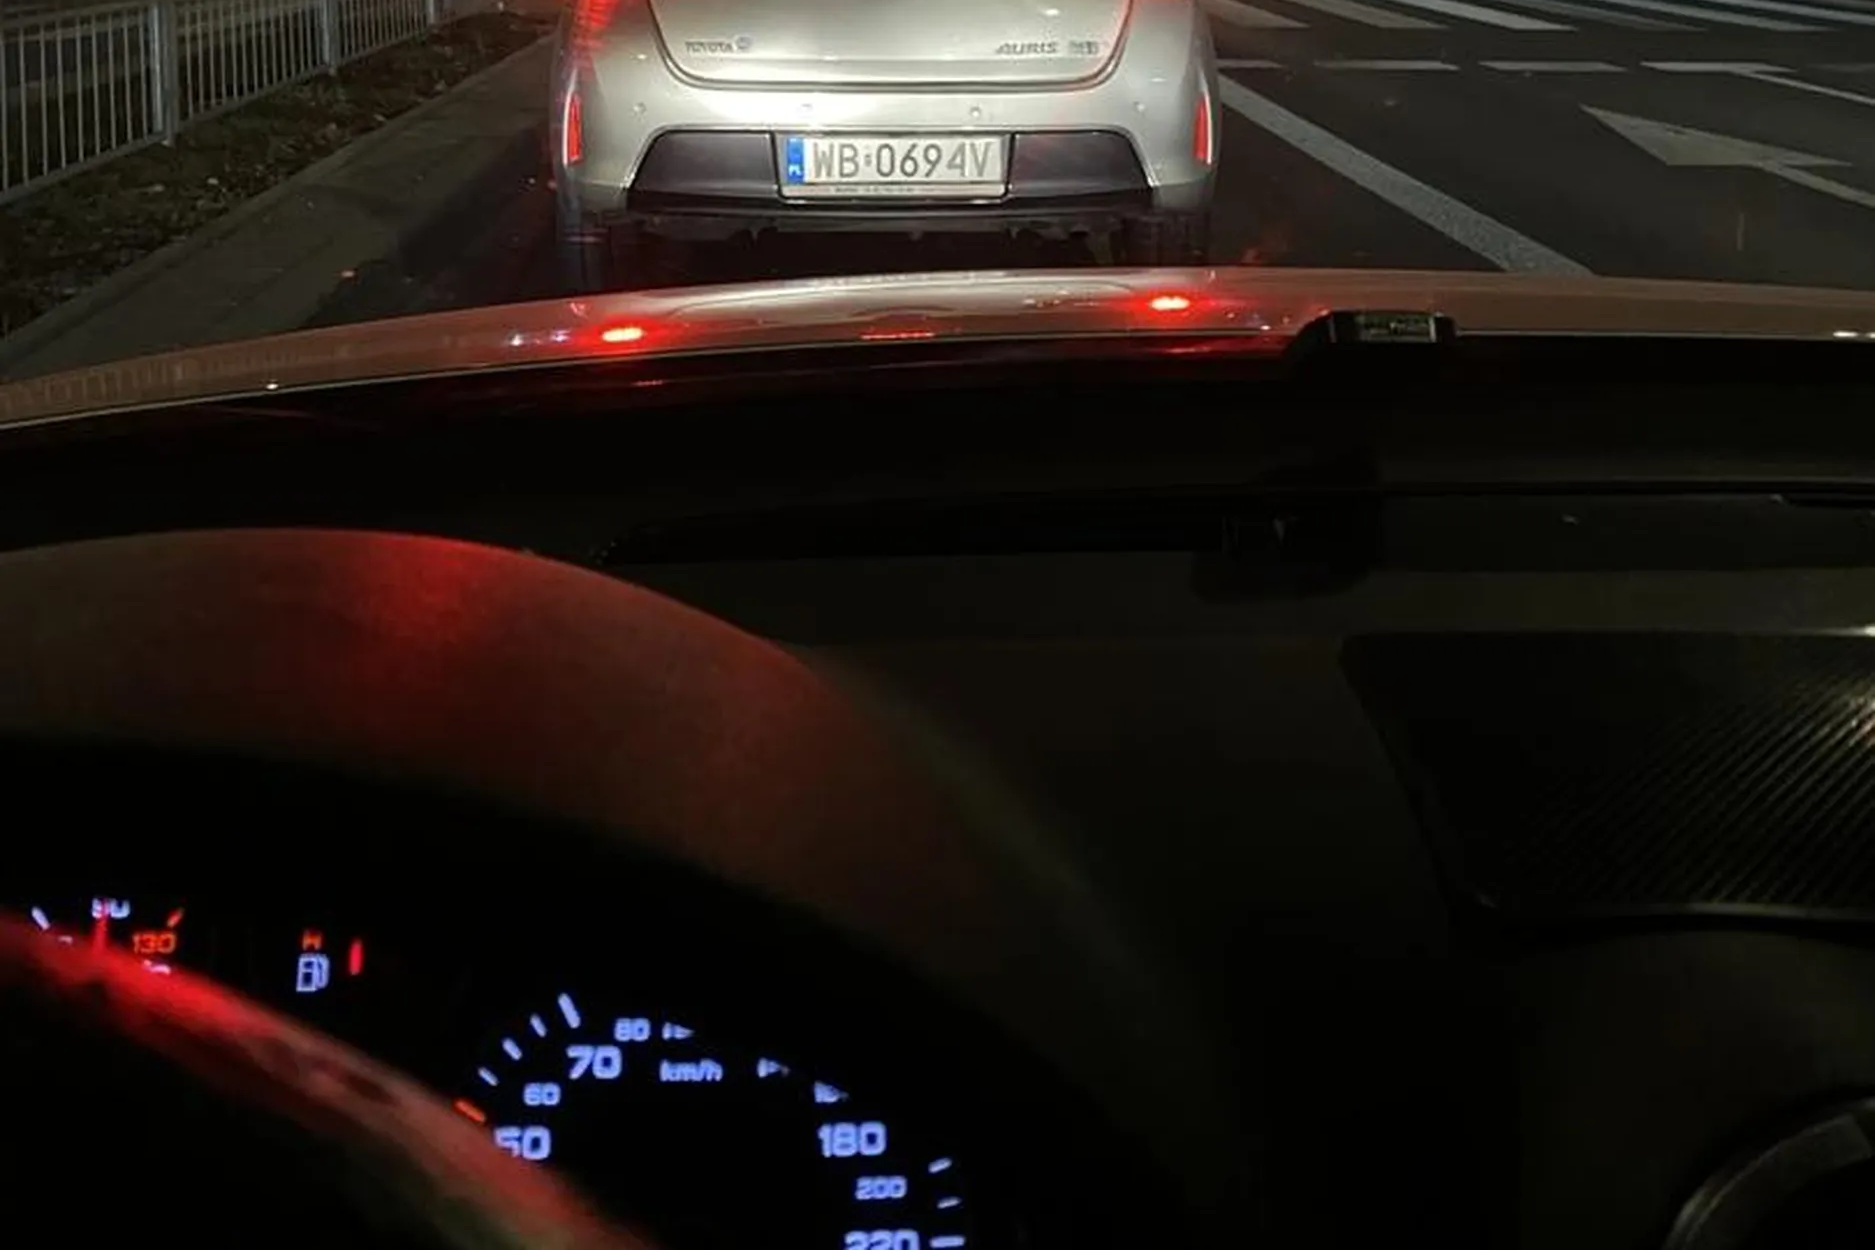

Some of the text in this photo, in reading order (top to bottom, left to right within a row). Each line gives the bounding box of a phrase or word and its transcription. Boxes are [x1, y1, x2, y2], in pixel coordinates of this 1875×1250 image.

[814, 142, 991, 178] WB 0694V
[132, 933, 177, 954] 130
[614, 1018, 651, 1042] 80
[566, 1045, 622, 1080] 70
[659, 1059, 723, 1082] km/h
[523, 1083, 561, 1106] 60
[495, 1126, 551, 1160] 50
[818, 1122, 887, 1157] 180
[855, 1176, 907, 1200] 200
